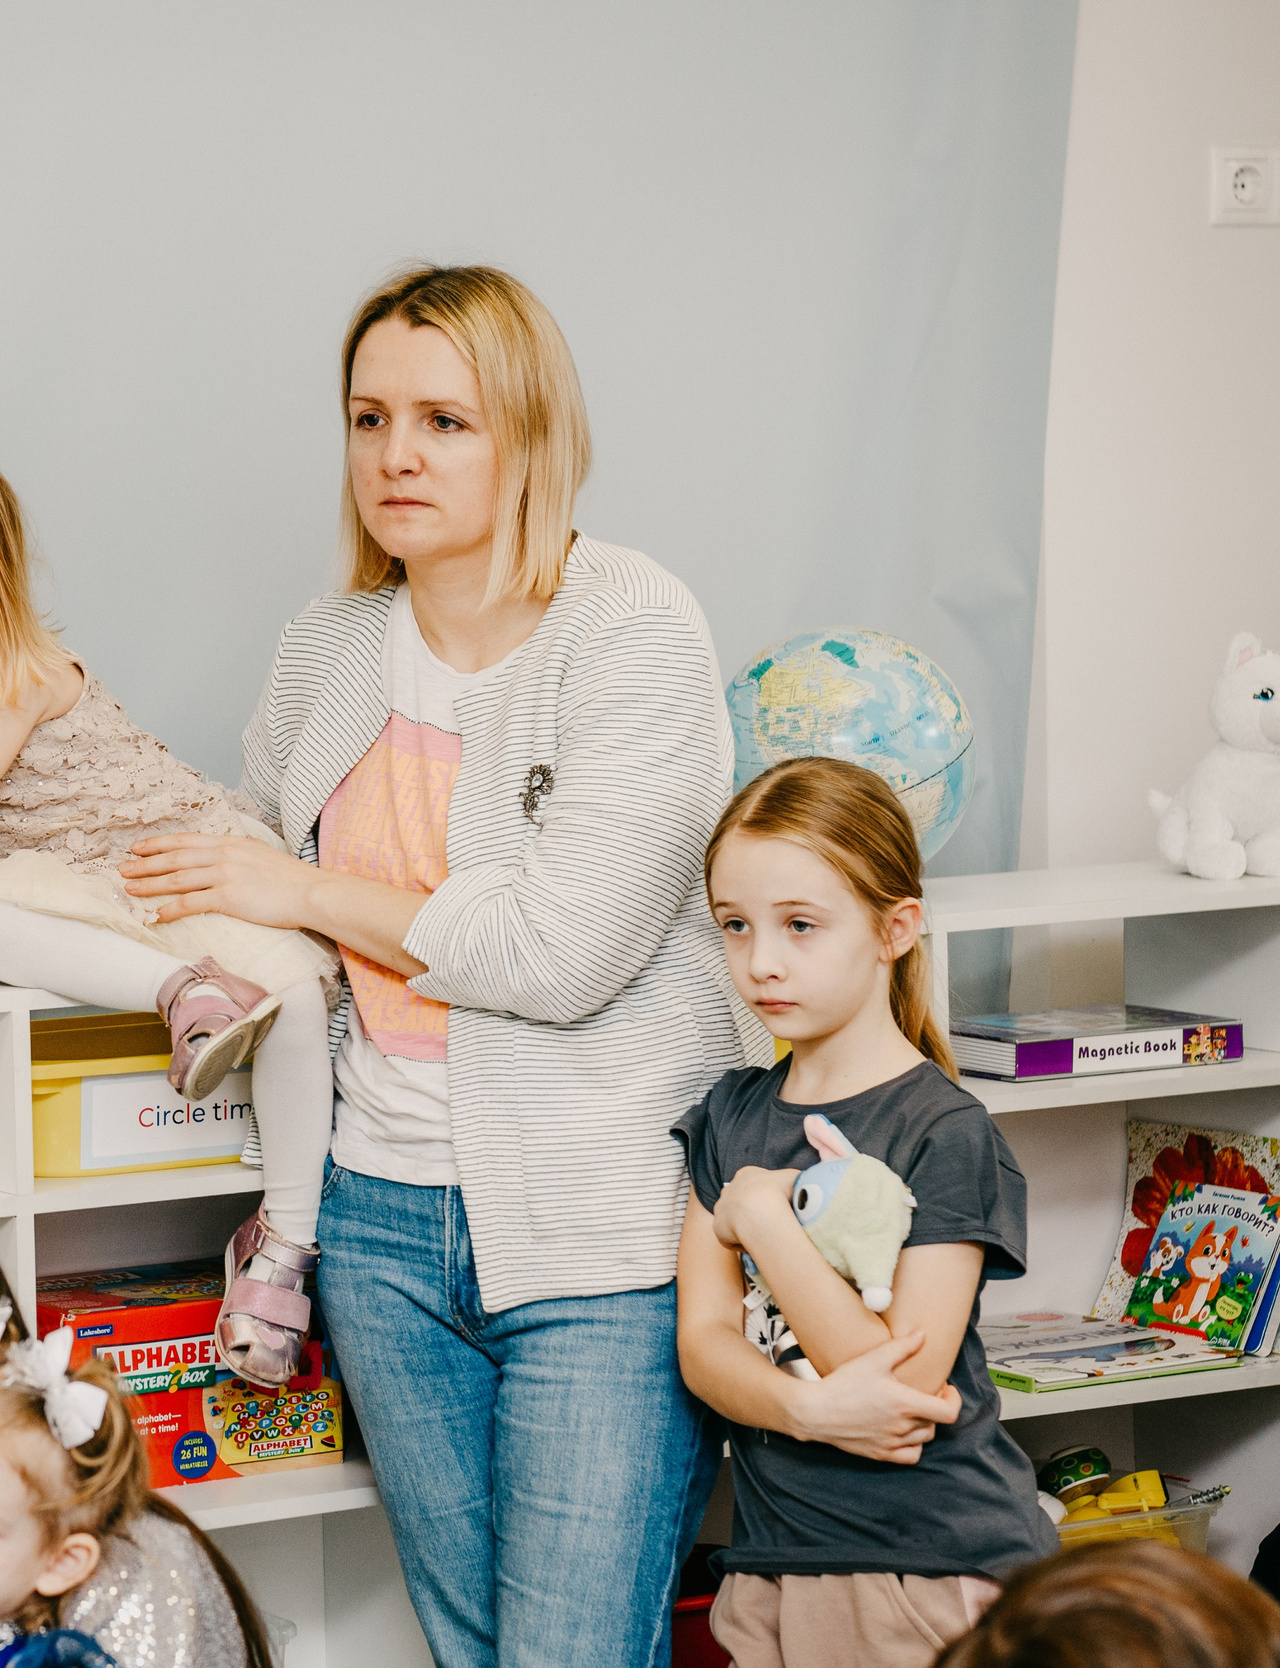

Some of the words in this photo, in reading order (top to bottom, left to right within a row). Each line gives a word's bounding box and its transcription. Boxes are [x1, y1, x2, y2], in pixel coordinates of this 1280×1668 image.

[1078, 1042, 1140, 1060] Magnetic
[1143, 1038, 1177, 1053] Book
[138, 1102, 205, 1128] Circle
[213, 1099, 253, 1122] tim
[1171, 1206, 1194, 1220] КТО
[1197, 1203, 1220, 1215] КАК
[1221, 1204, 1275, 1237] ГОВОРИТ?
[79, 1326, 112, 1338] Lakeshore
[181, 1369, 210, 1385] BOX
[158, 1422, 179, 1433] time!
[253, 1438, 309, 1452] ALPHABET
[180, 1449, 191, 1460] 26
[193, 1446, 208, 1458] FUN
